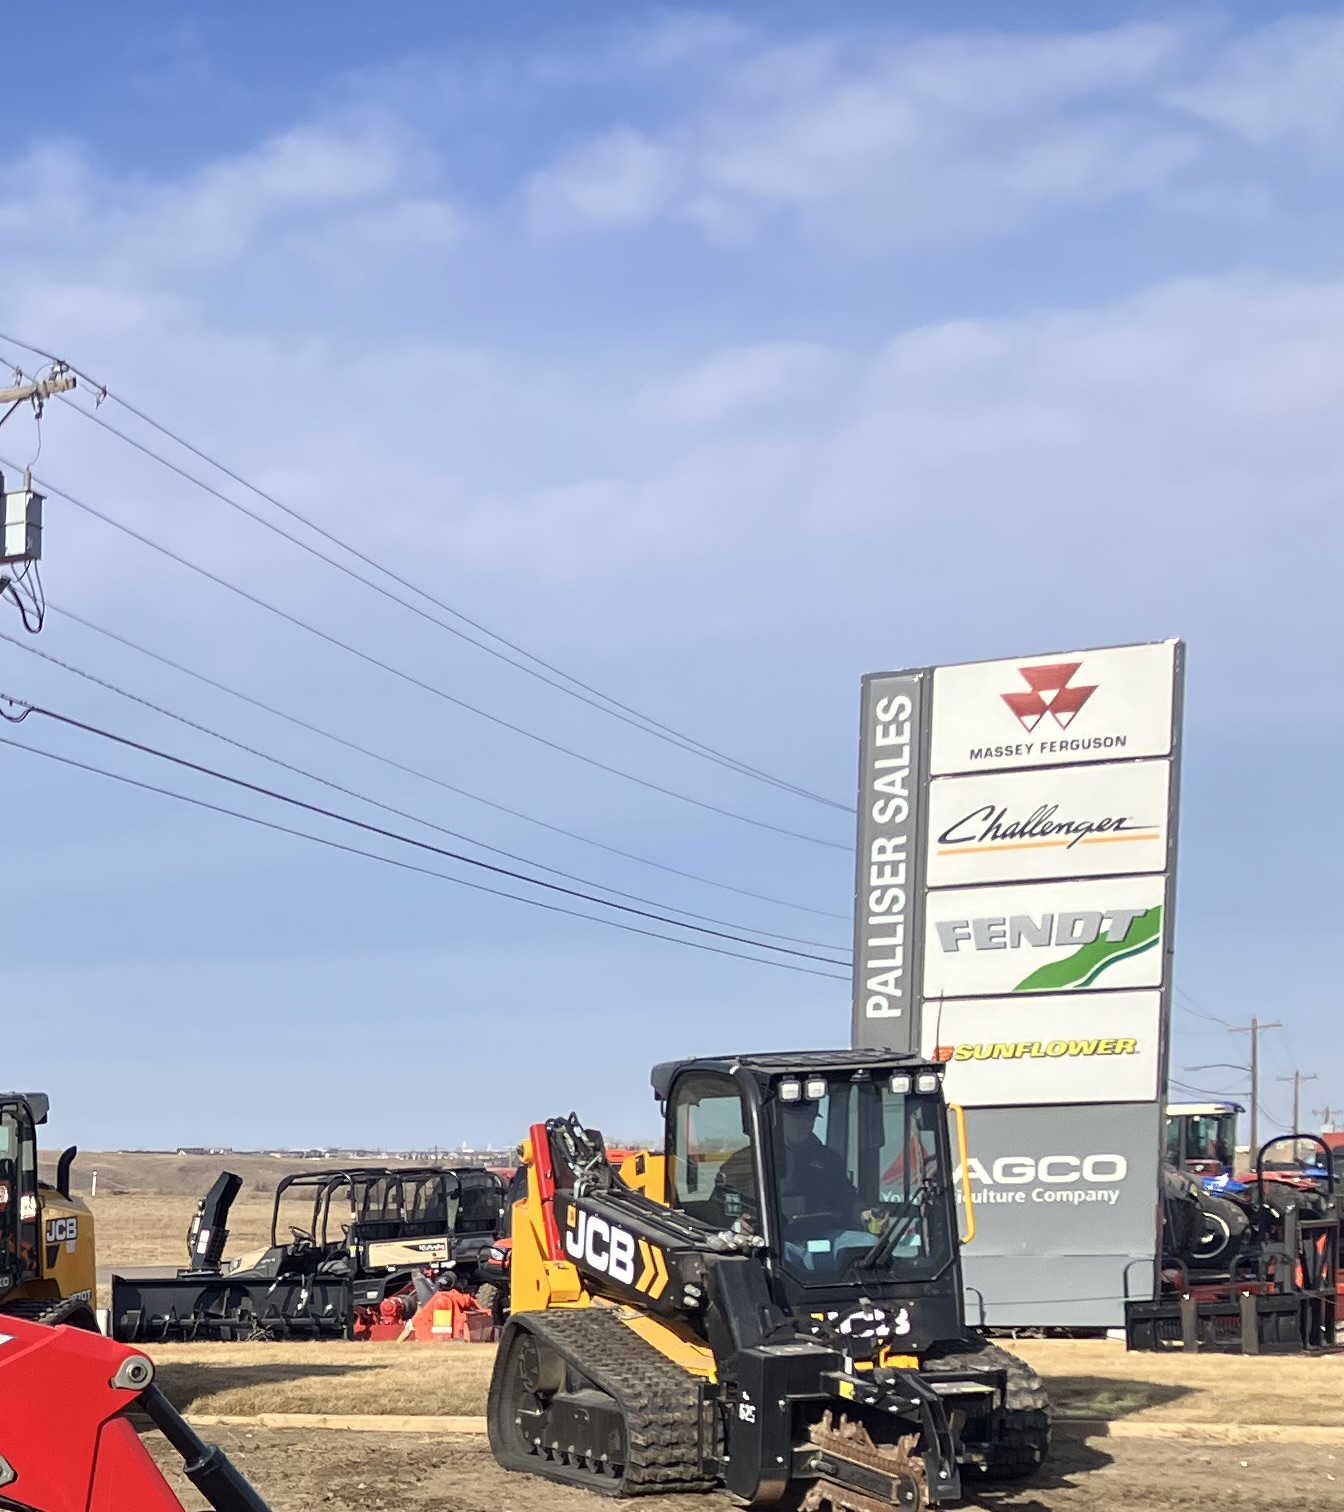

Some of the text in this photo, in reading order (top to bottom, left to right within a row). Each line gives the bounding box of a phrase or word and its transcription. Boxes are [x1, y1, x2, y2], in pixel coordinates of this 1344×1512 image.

[969, 735, 1127, 760] MASSEY FERGUSON
[937, 804, 1159, 850] Challenger
[866, 694, 912, 1020] PALLISER SALES
[936, 908, 1151, 954] FENDT
[953, 1037, 1138, 1062] SUNFLOWER
[953, 1153, 1128, 1186] AGCO
[1031, 1187, 1120, 1206] Company
[45, 1217, 78, 1243] JCB
[565, 1209, 636, 1285] JCB
